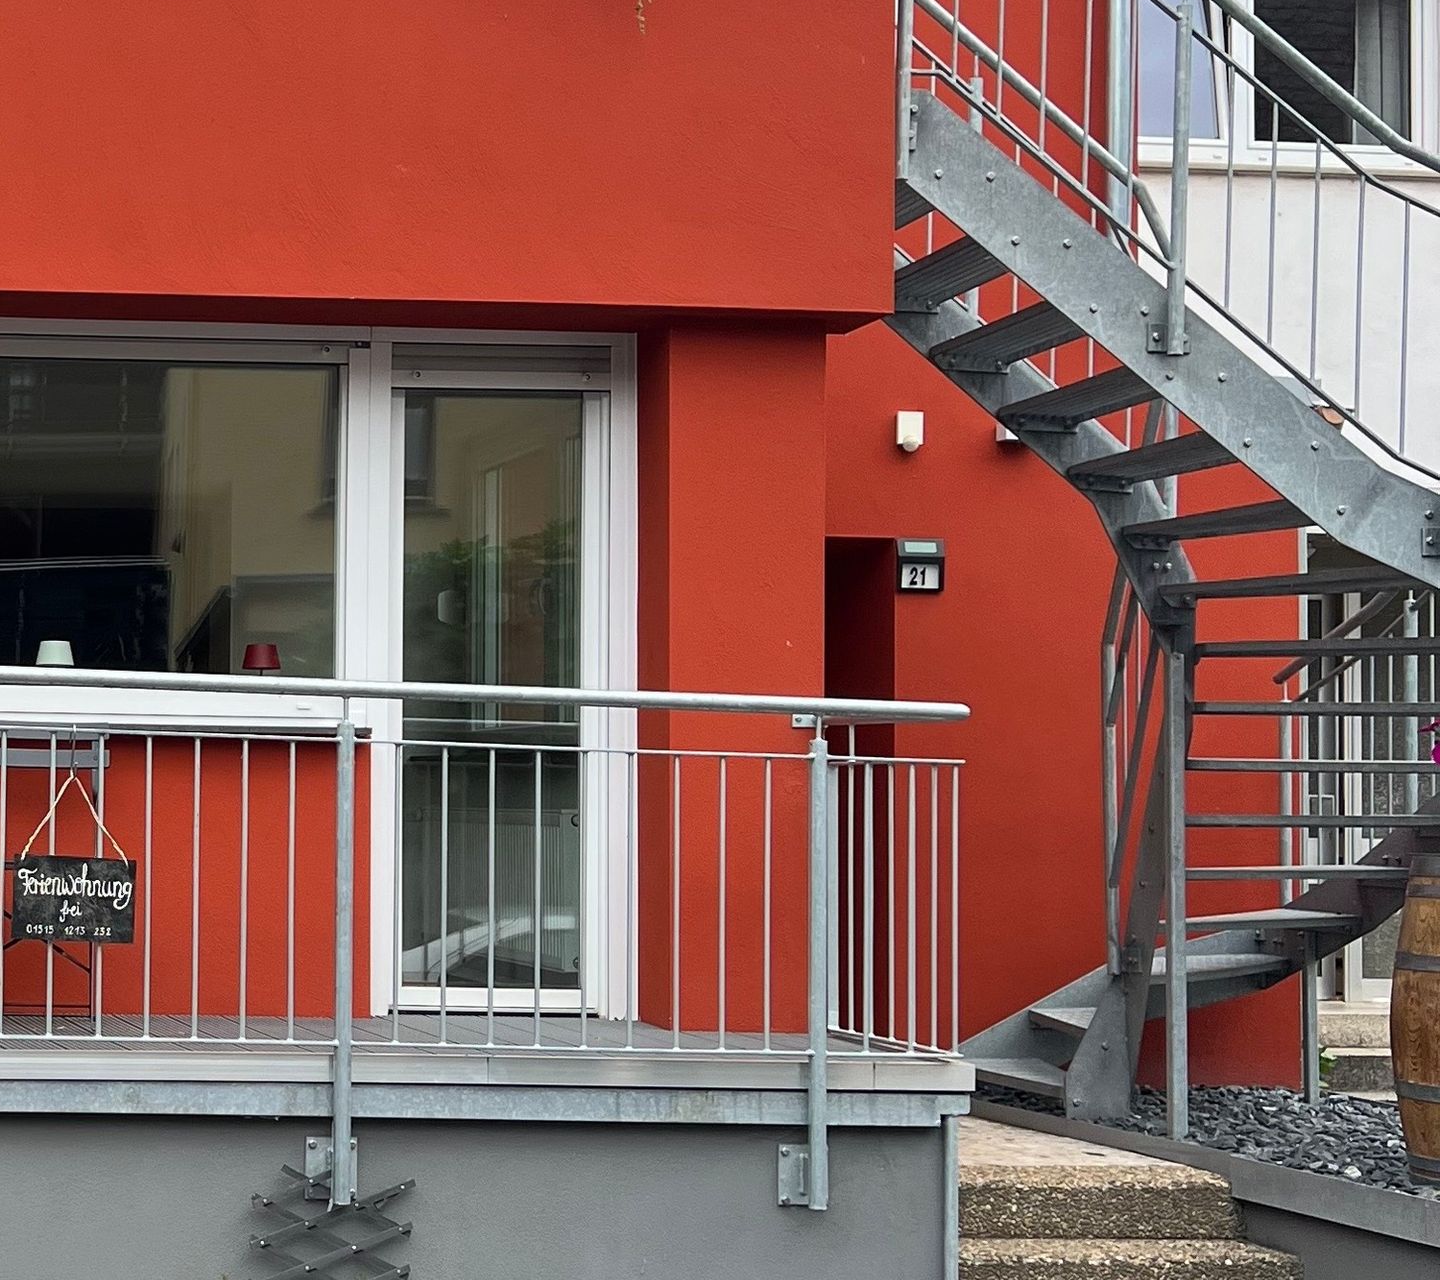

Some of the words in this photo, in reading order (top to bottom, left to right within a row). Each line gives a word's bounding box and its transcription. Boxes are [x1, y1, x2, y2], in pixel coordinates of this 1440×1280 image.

[910, 567, 926, 585] 21
[18, 863, 132, 910] Ferienwohnung
[59, 900, 82, 923] frei
